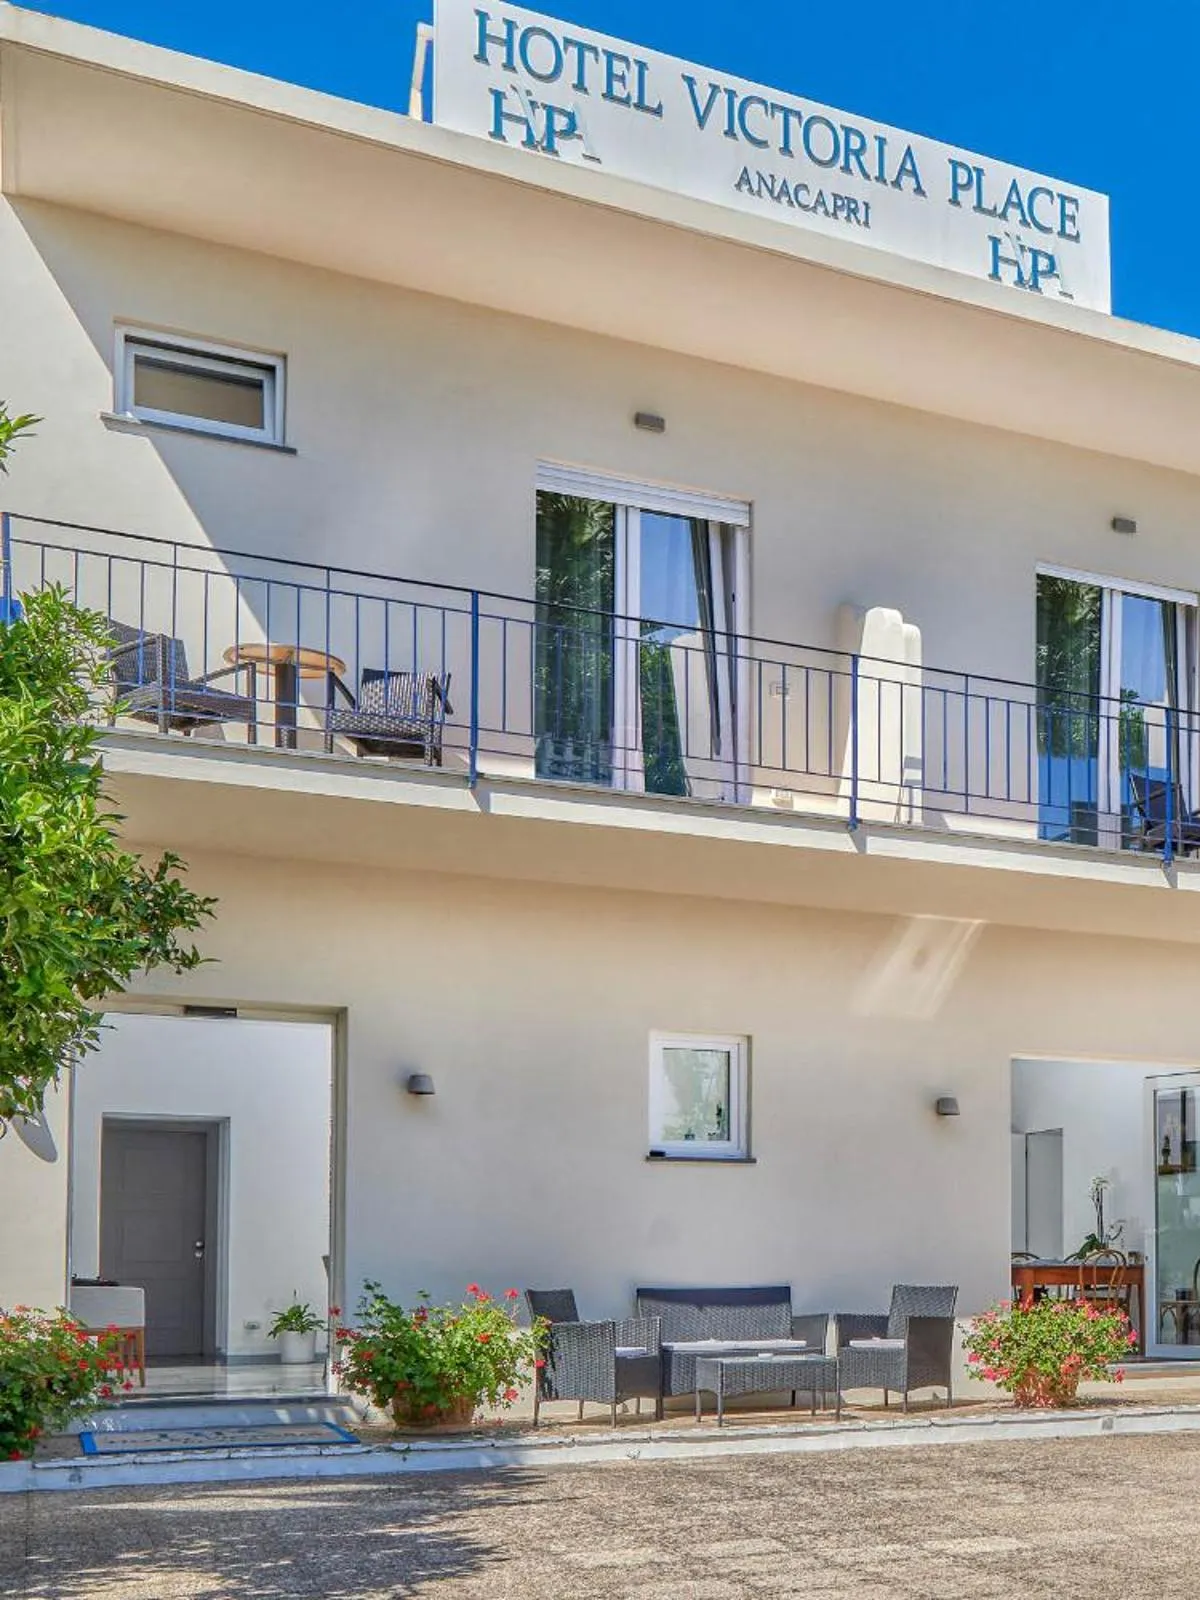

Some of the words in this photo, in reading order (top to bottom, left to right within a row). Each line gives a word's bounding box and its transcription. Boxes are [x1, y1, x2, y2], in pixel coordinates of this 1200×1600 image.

[473, 8, 663, 119] HOTEL
[681, 73, 927, 198] VICTORIA
[948, 158, 1081, 243] PLACE
[734, 165, 871, 229] ANACAPRI
